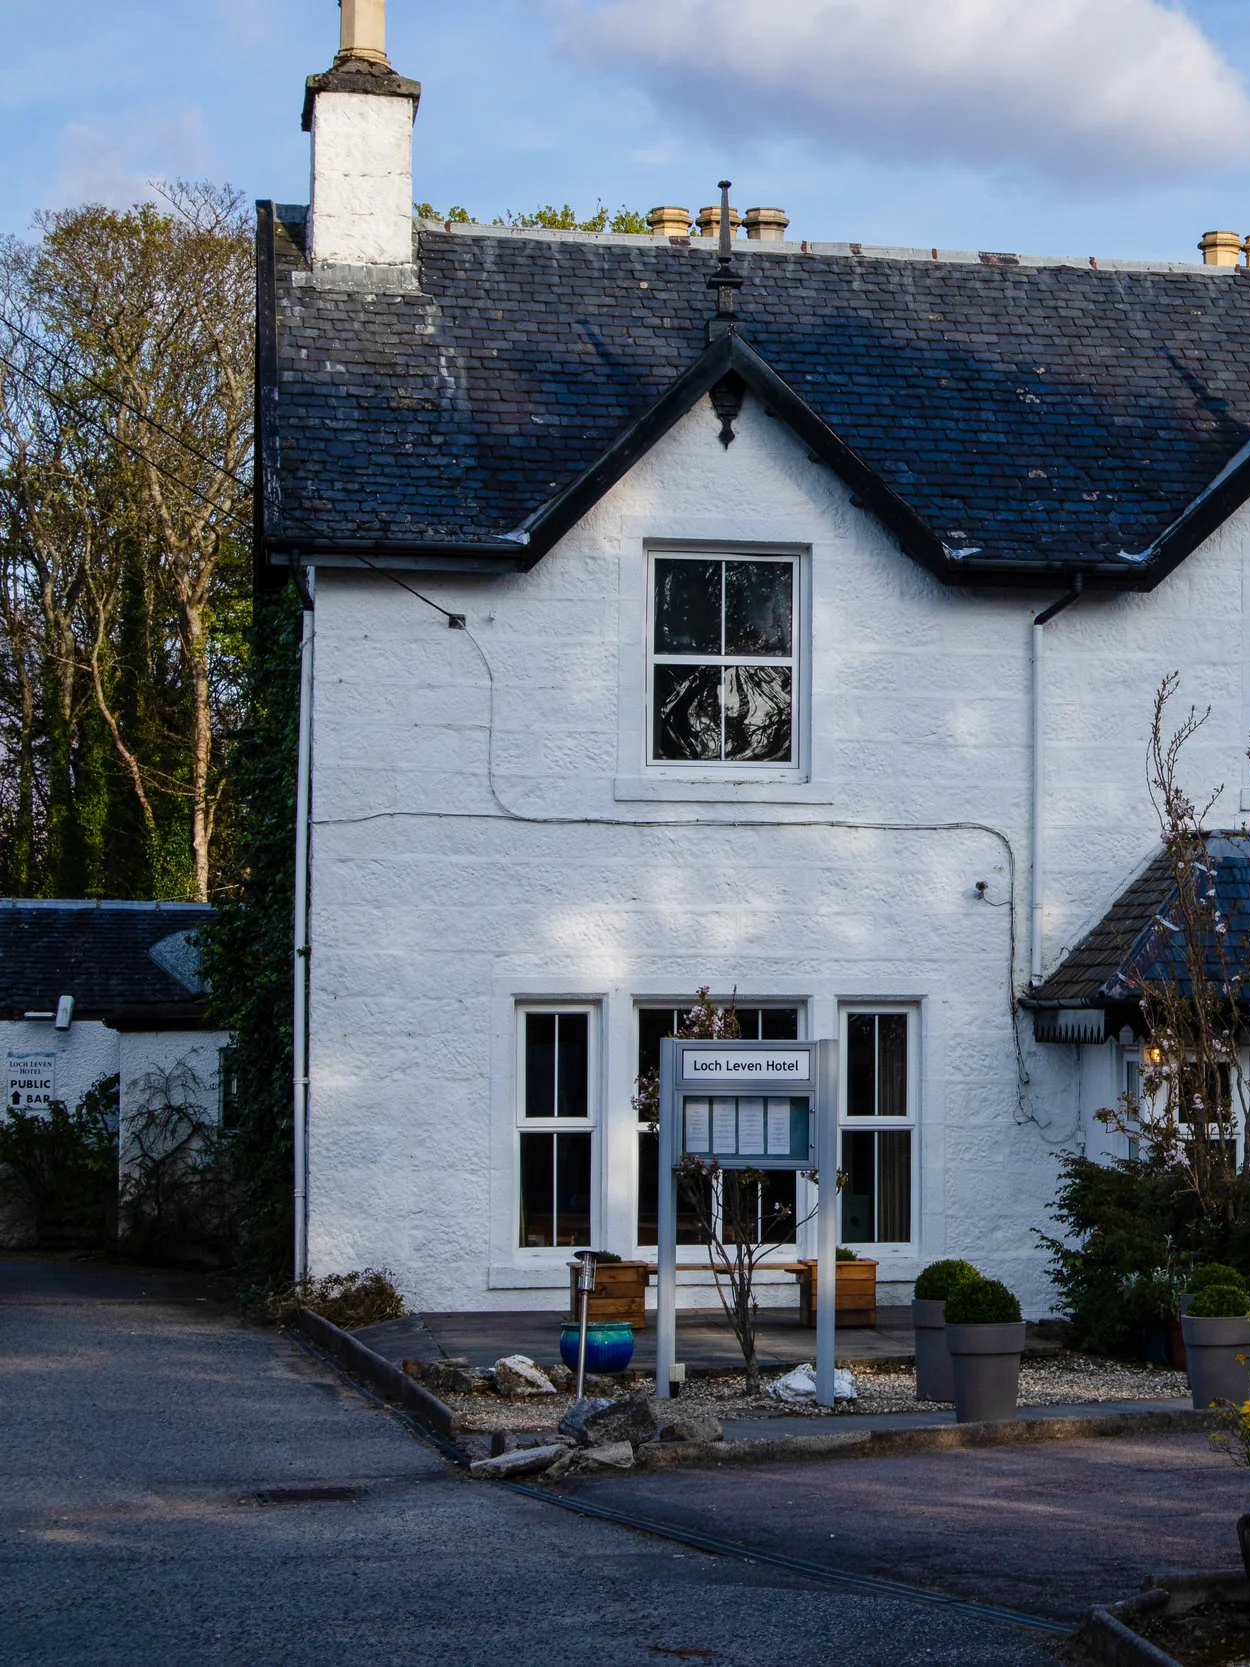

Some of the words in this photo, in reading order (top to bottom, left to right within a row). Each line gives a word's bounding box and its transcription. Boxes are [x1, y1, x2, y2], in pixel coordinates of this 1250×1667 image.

[694, 1060, 722, 1071] Loch
[726, 1060, 762, 1071] Leven
[767, 1060, 799, 1071] Hotel
[10, 1080, 51, 1089] PUBLIC
[26, 1094, 50, 1103] BAR
